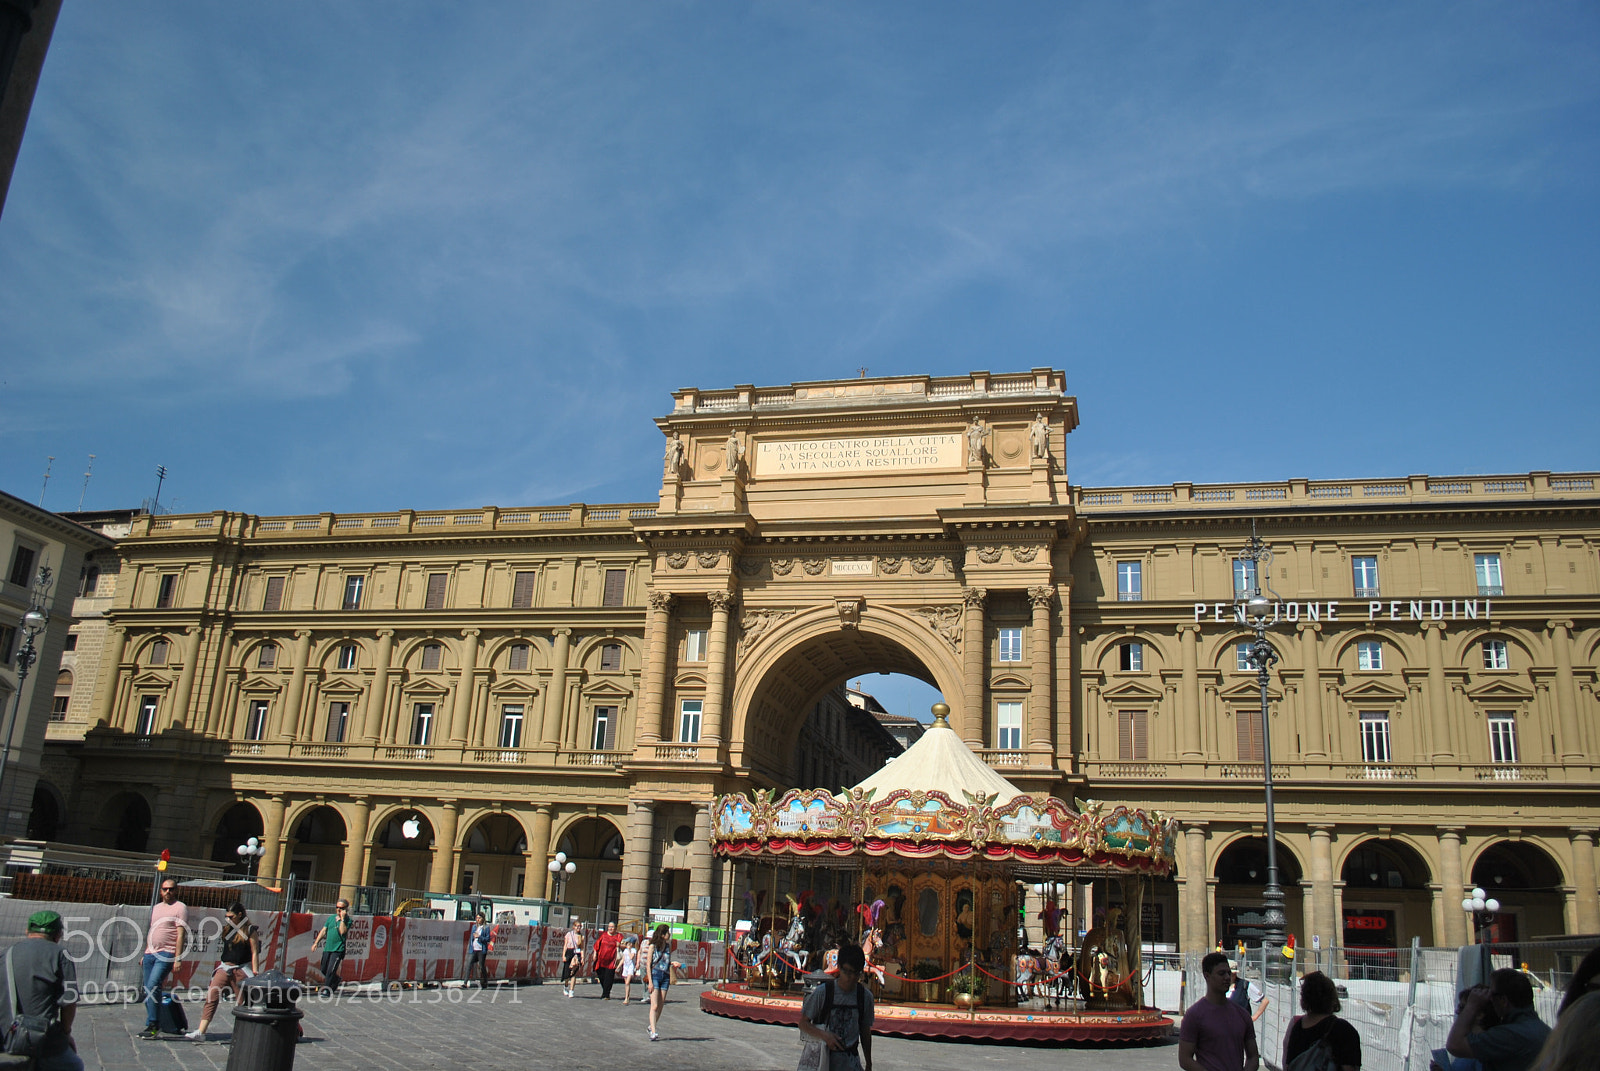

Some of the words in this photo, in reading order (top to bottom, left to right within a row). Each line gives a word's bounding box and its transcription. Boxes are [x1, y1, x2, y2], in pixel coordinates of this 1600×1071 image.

[776, 442, 818, 452] ANTICO
[821, 439, 870, 450] CENTRO
[874, 438, 915, 447] DELLA
[779, 453, 794, 462] DA
[798, 450, 861, 460] SECOLARE
[865, 446, 938, 457] SQUALLORE
[779, 463, 786, 471] A
[790, 461, 817, 470] VITA
[821, 459, 861, 469] NUOVA
[866, 456, 938, 467] RESTITUITO
[1194, 601, 1339, 623] PENIONE
[1369, 599, 1491, 621] PENDINI
[350, 920, 370, 929] SCITA
[346, 931, 369, 940] AZIONE
[345, 948, 364, 956] HIFANO
